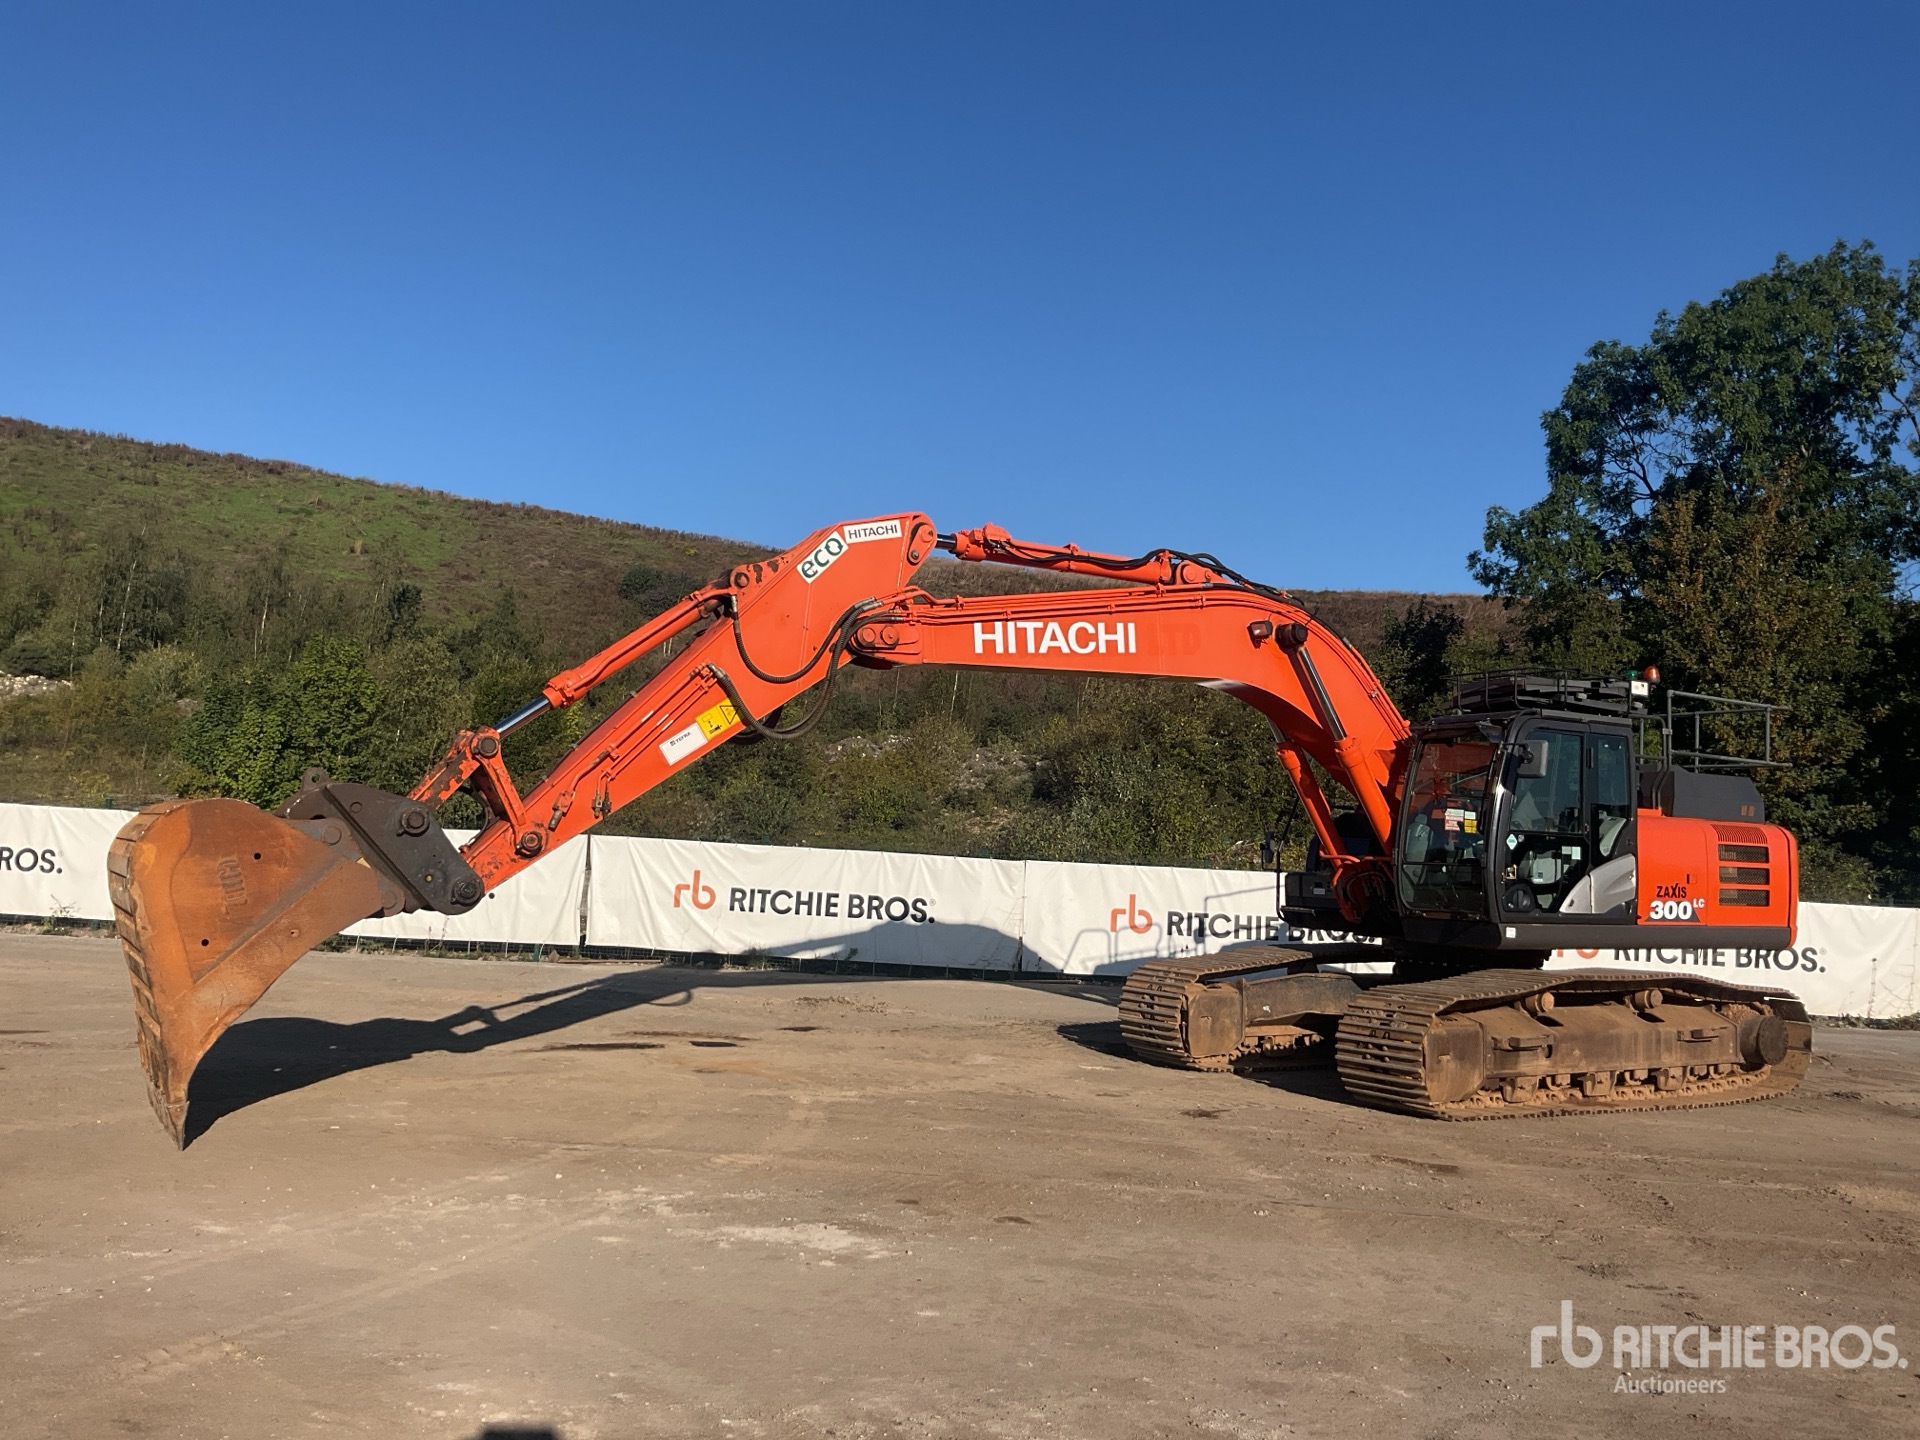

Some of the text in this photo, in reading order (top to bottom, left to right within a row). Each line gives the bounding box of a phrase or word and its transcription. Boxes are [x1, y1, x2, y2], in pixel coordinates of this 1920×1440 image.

[848, 524, 898, 540] HITACHI
[801, 537, 844, 579] eco
[973, 621, 1137, 654] HITACHI
[673, 870, 936, 924] rb RITCHIE BROS.
[1656, 882, 1687, 899] ZAXIS
[1110, 894, 1153, 934] rb
[1166, 910, 1280, 941] RITCHIE
[1649, 898, 1705, 920] 300 LC
[1735, 946, 1827, 973] BROS.
